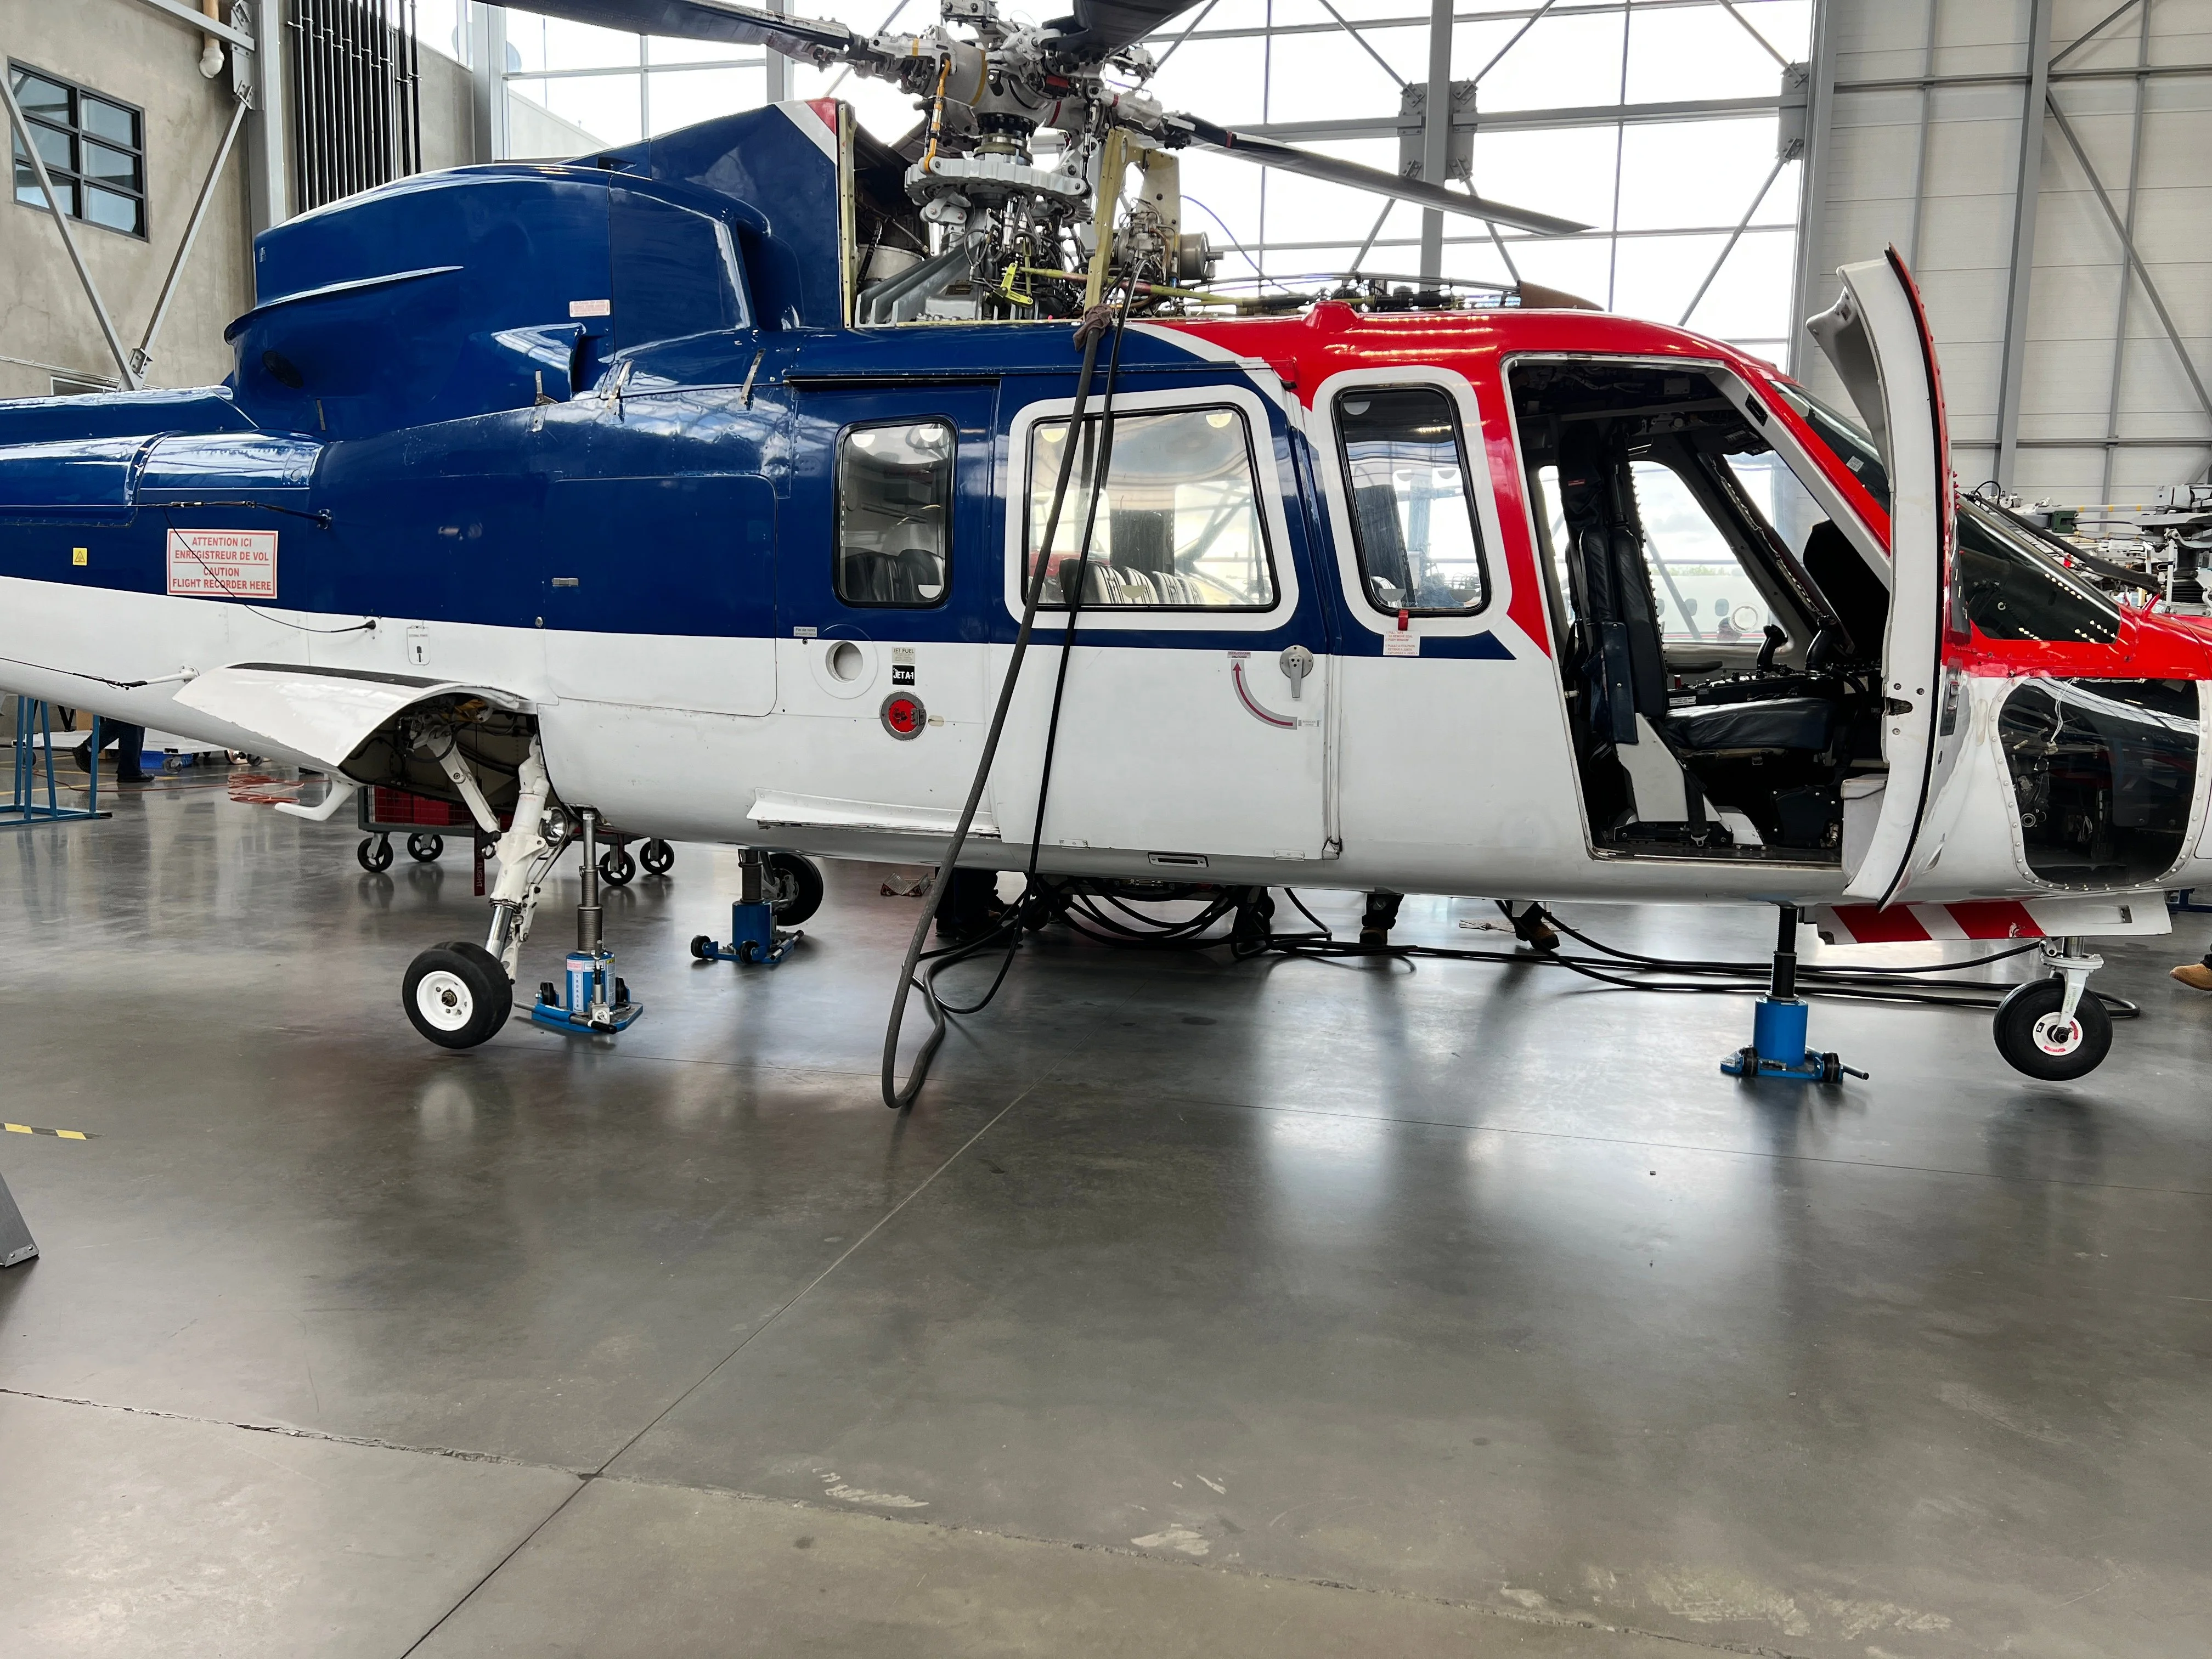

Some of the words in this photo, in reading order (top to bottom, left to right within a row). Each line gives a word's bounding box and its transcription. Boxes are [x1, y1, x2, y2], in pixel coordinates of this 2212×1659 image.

[191, 537, 238, 546] ATTENTION
[241, 538, 252, 547] ICI
[175, 550, 237, 560] ENREGISTREUR
[240, 551, 250, 560] DE
[253, 552, 269, 561] VOL
[204, 567, 240, 577] CAUTION
[173, 578, 201, 588] FLIGHT
[204, 579, 247, 590] RECORDER
[250, 581, 272, 590] HERE
[893, 671, 905, 679] JET
[905, 671, 914, 680] A-1
